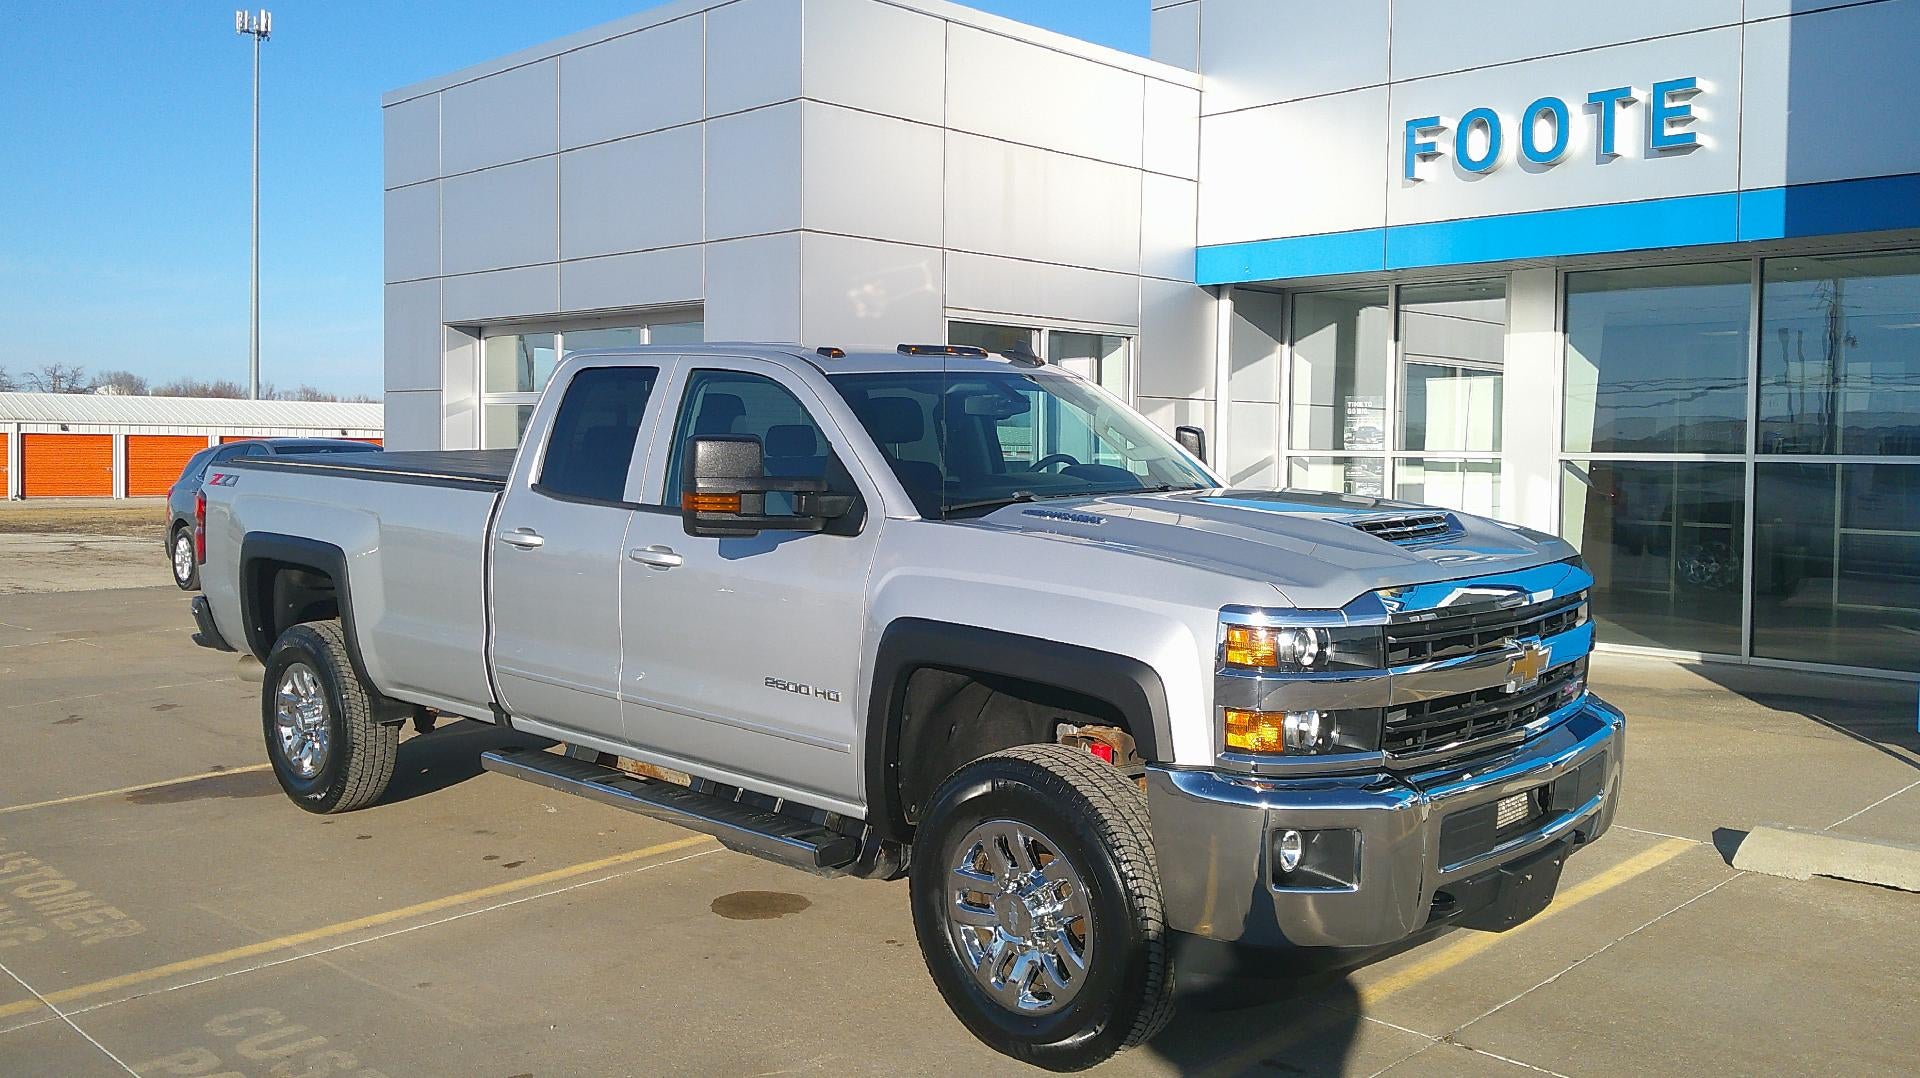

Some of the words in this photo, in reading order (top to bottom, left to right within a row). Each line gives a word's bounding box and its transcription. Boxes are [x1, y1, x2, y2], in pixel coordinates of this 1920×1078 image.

[1404, 76, 1699, 182] FOOTE
[764, 676, 811, 697] 2500
[814, 686, 841, 703] HD
